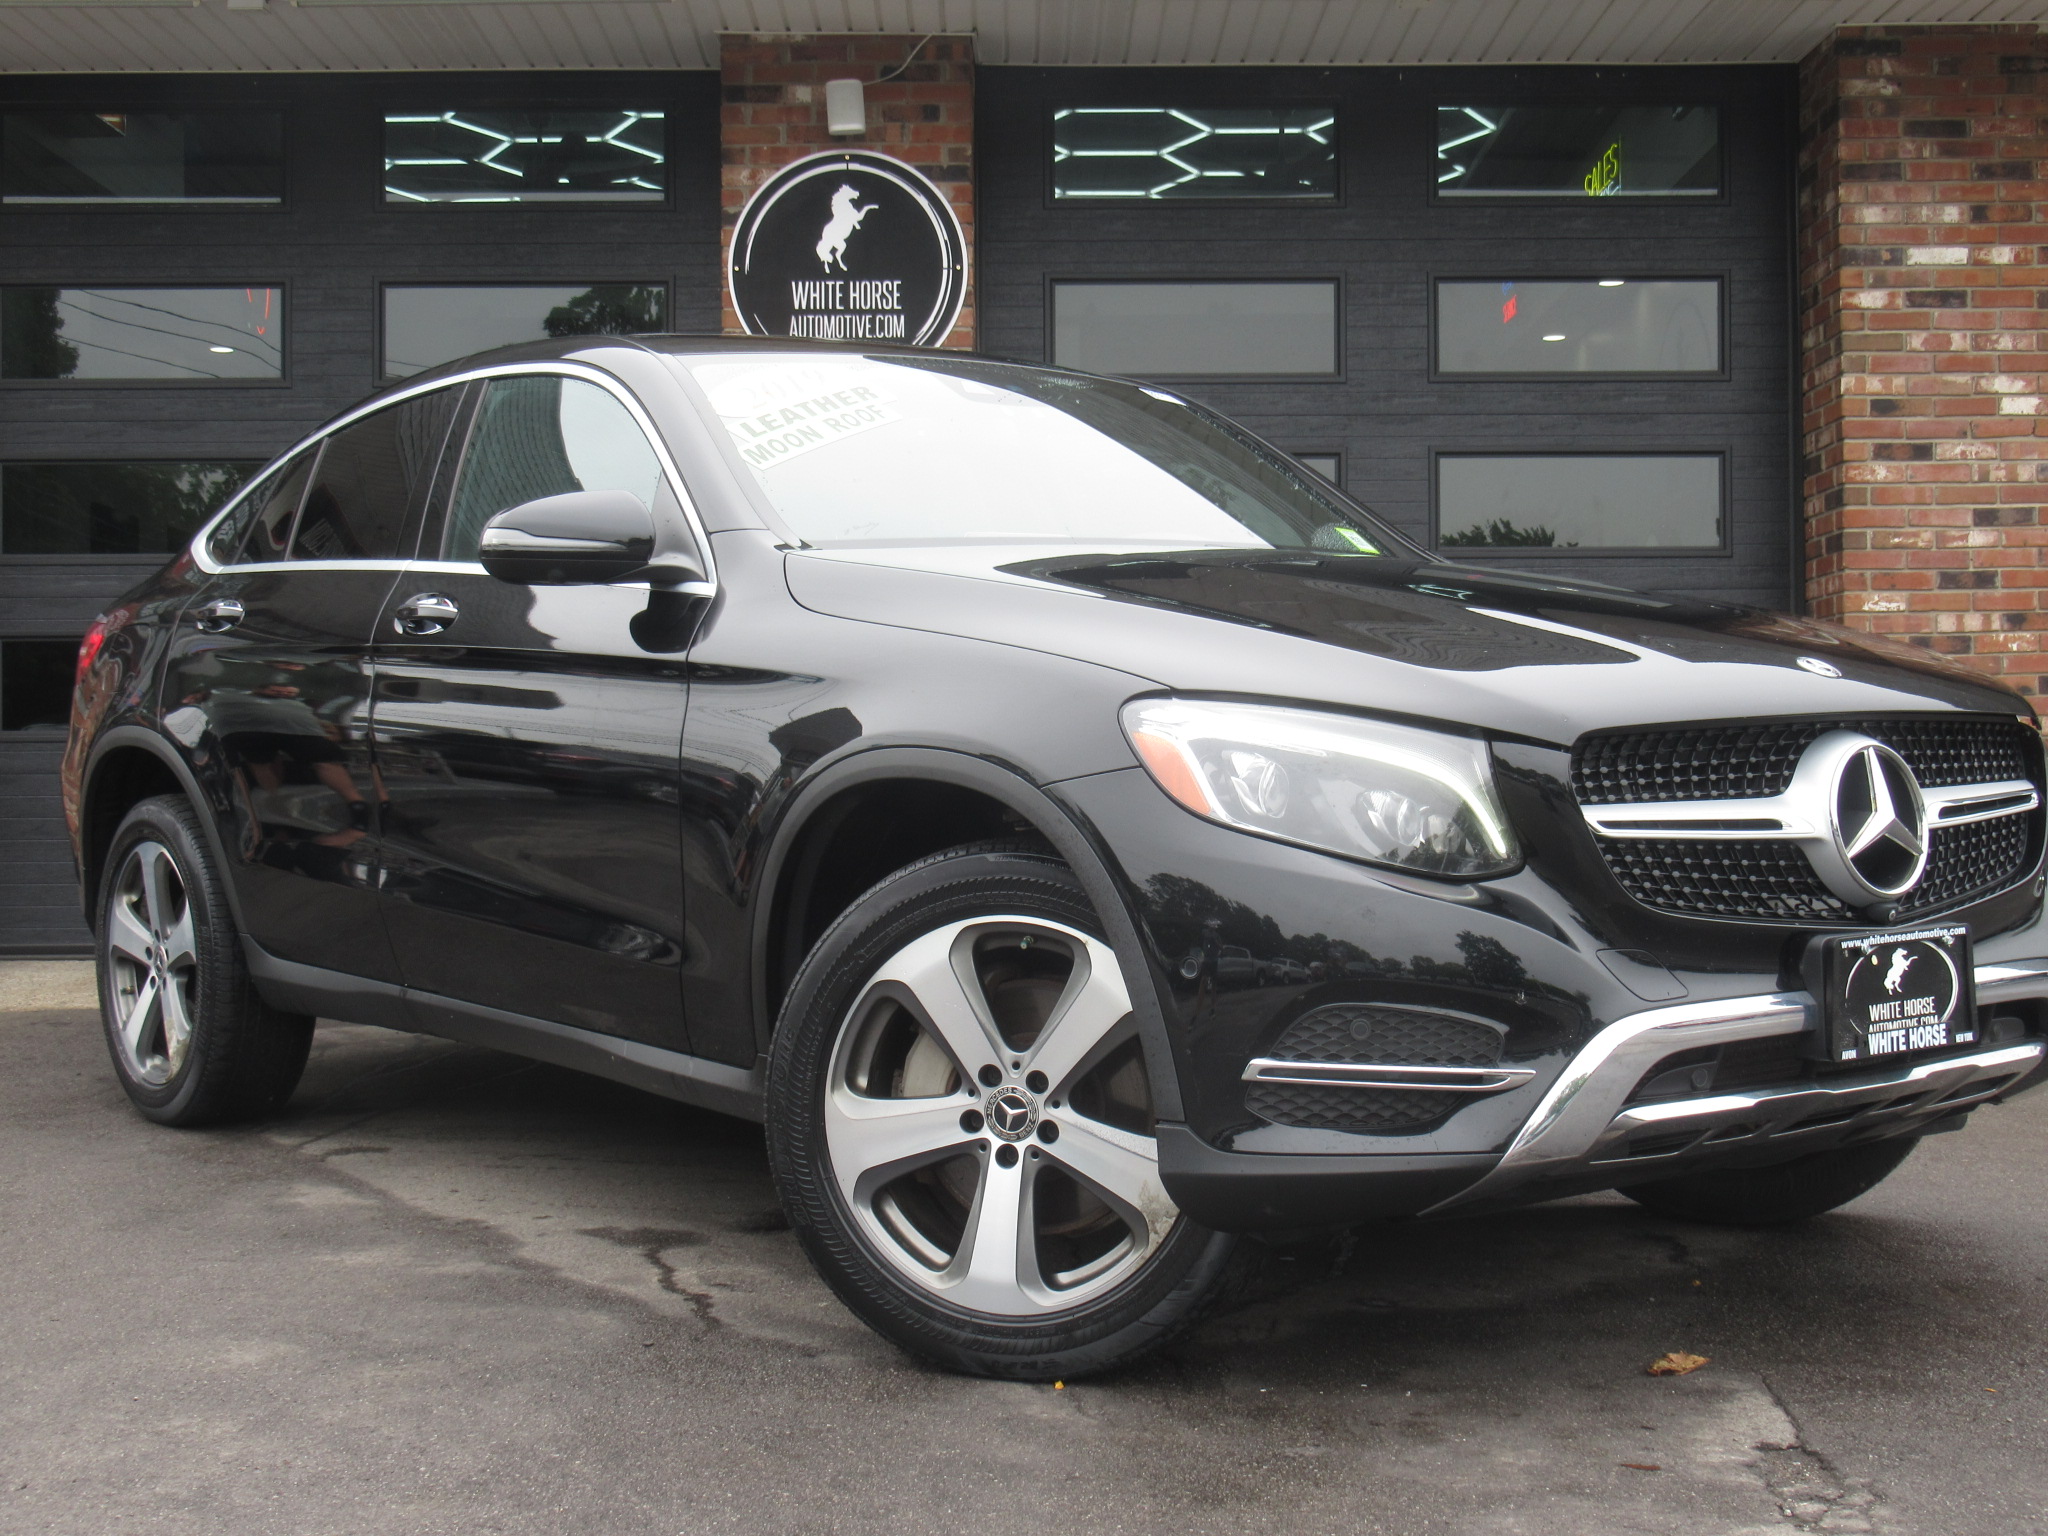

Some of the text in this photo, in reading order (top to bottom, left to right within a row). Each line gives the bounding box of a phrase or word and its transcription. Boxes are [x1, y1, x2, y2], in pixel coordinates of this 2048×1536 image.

[1584, 143, 1617, 196] SALES
[792, 281, 902, 310] WHITE HORSE
[790, 315, 905, 338] AUTOMOTIVE.COM
[739, 386, 879, 438] LEATHER
[743, 404, 886, 465] MOON ROOF
[1841, 927, 1966, 949] www.whitehorseautomotive.com
[1869, 997, 1935, 1021] WHITE HORSE
[1868, 1024, 1946, 1055] WHITE HORSE
[986, 1087, 1013, 1114] MERCEDES
[1019, 1122, 1035, 1140] BENZ
